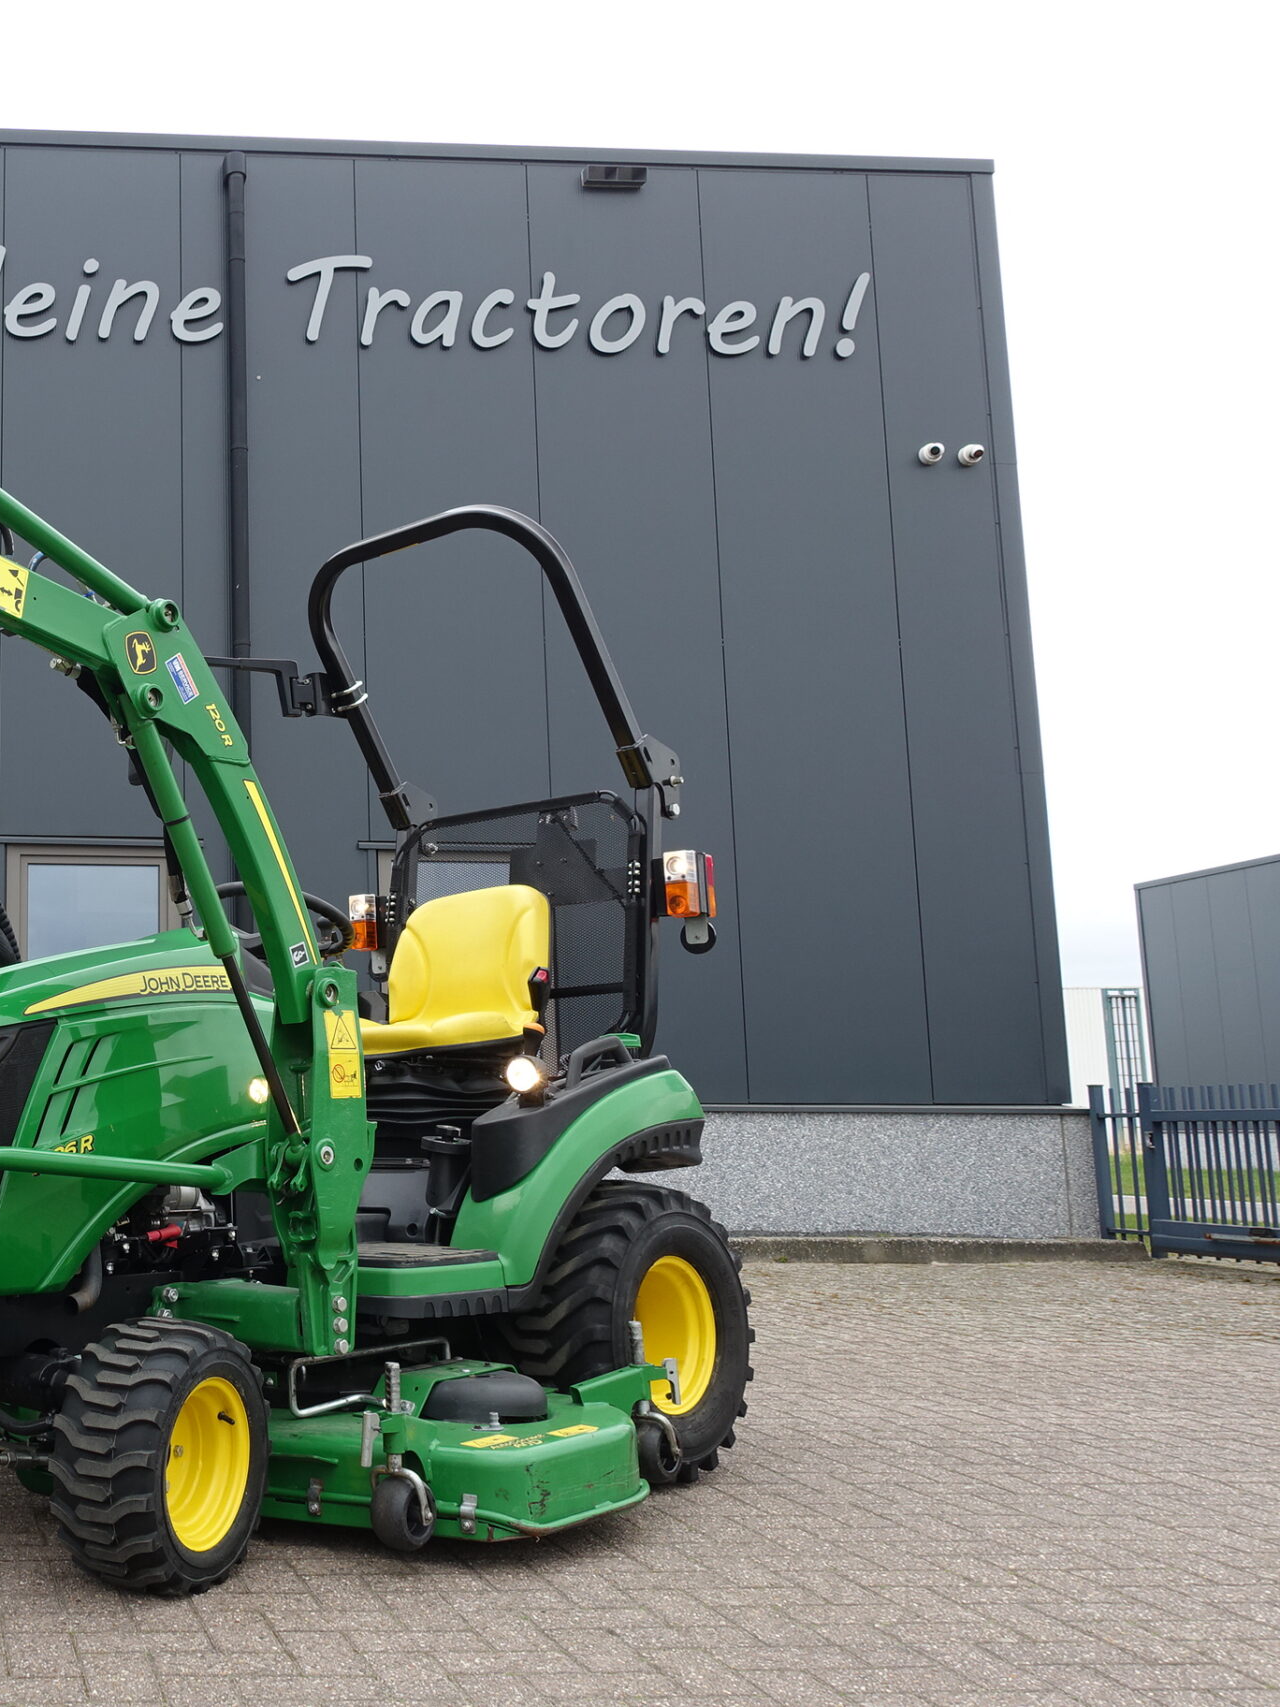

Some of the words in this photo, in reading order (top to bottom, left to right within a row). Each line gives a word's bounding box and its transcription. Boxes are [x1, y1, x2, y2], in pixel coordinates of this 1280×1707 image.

[287, 255, 870, 358] Tractoren!
[140, 975, 181, 993] JOHN
[182, 972, 229, 989] DEERE
